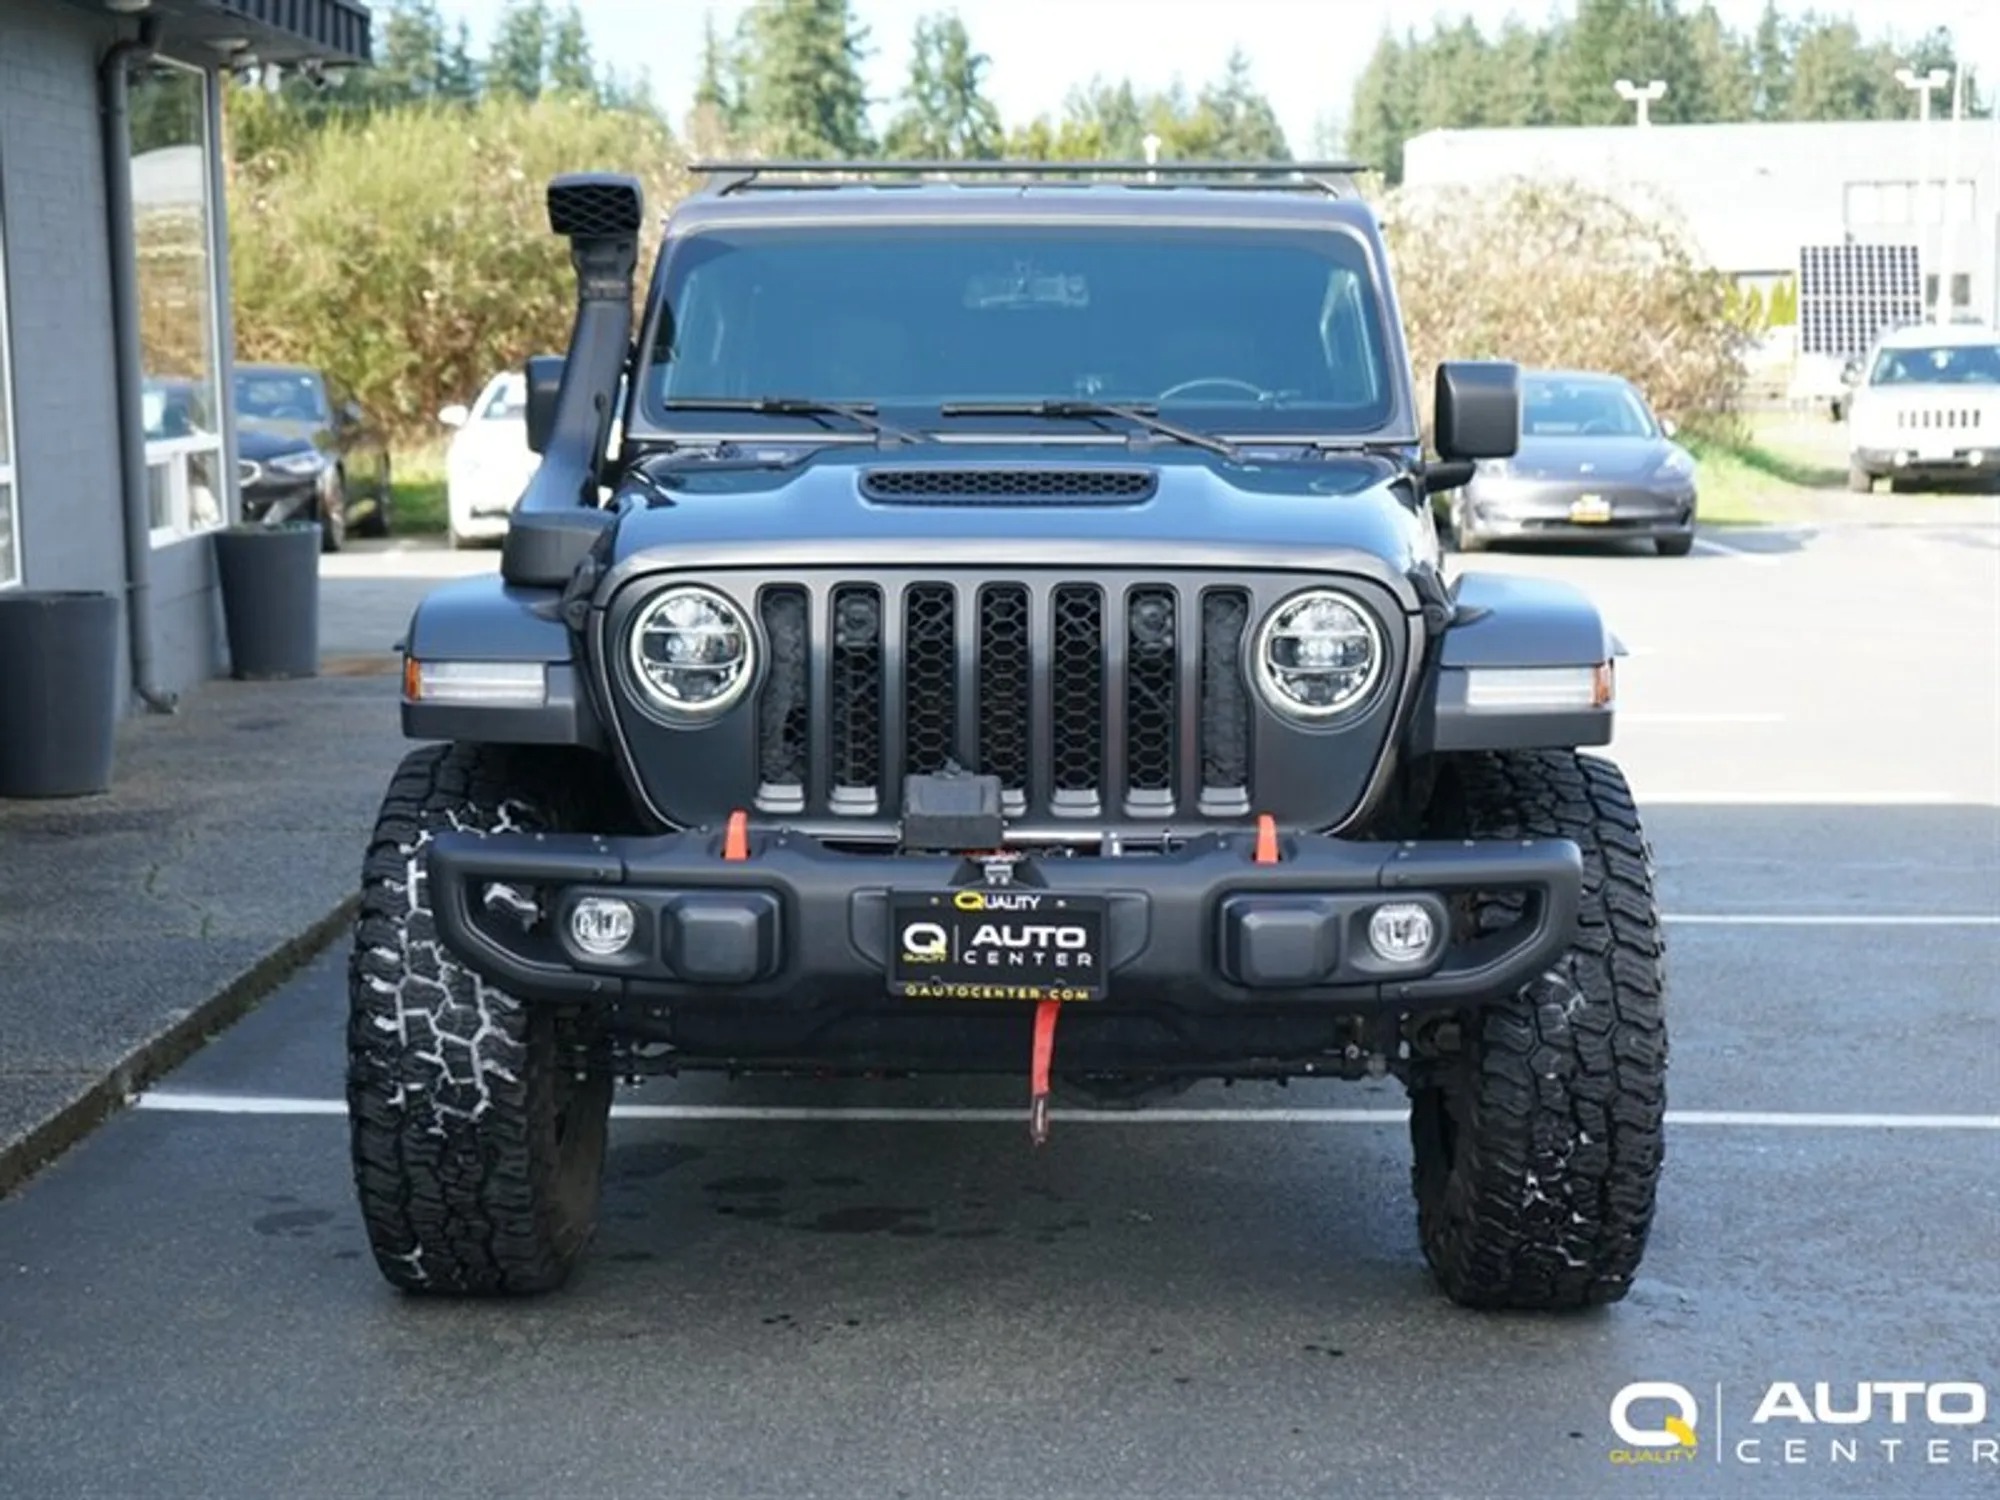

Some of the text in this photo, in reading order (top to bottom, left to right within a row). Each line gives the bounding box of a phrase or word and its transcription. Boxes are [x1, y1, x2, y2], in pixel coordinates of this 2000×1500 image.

[954, 891, 1041, 910] QUALITY
[972, 925, 1086, 947] AUTO
[964, 950, 1092, 967] CENTER
